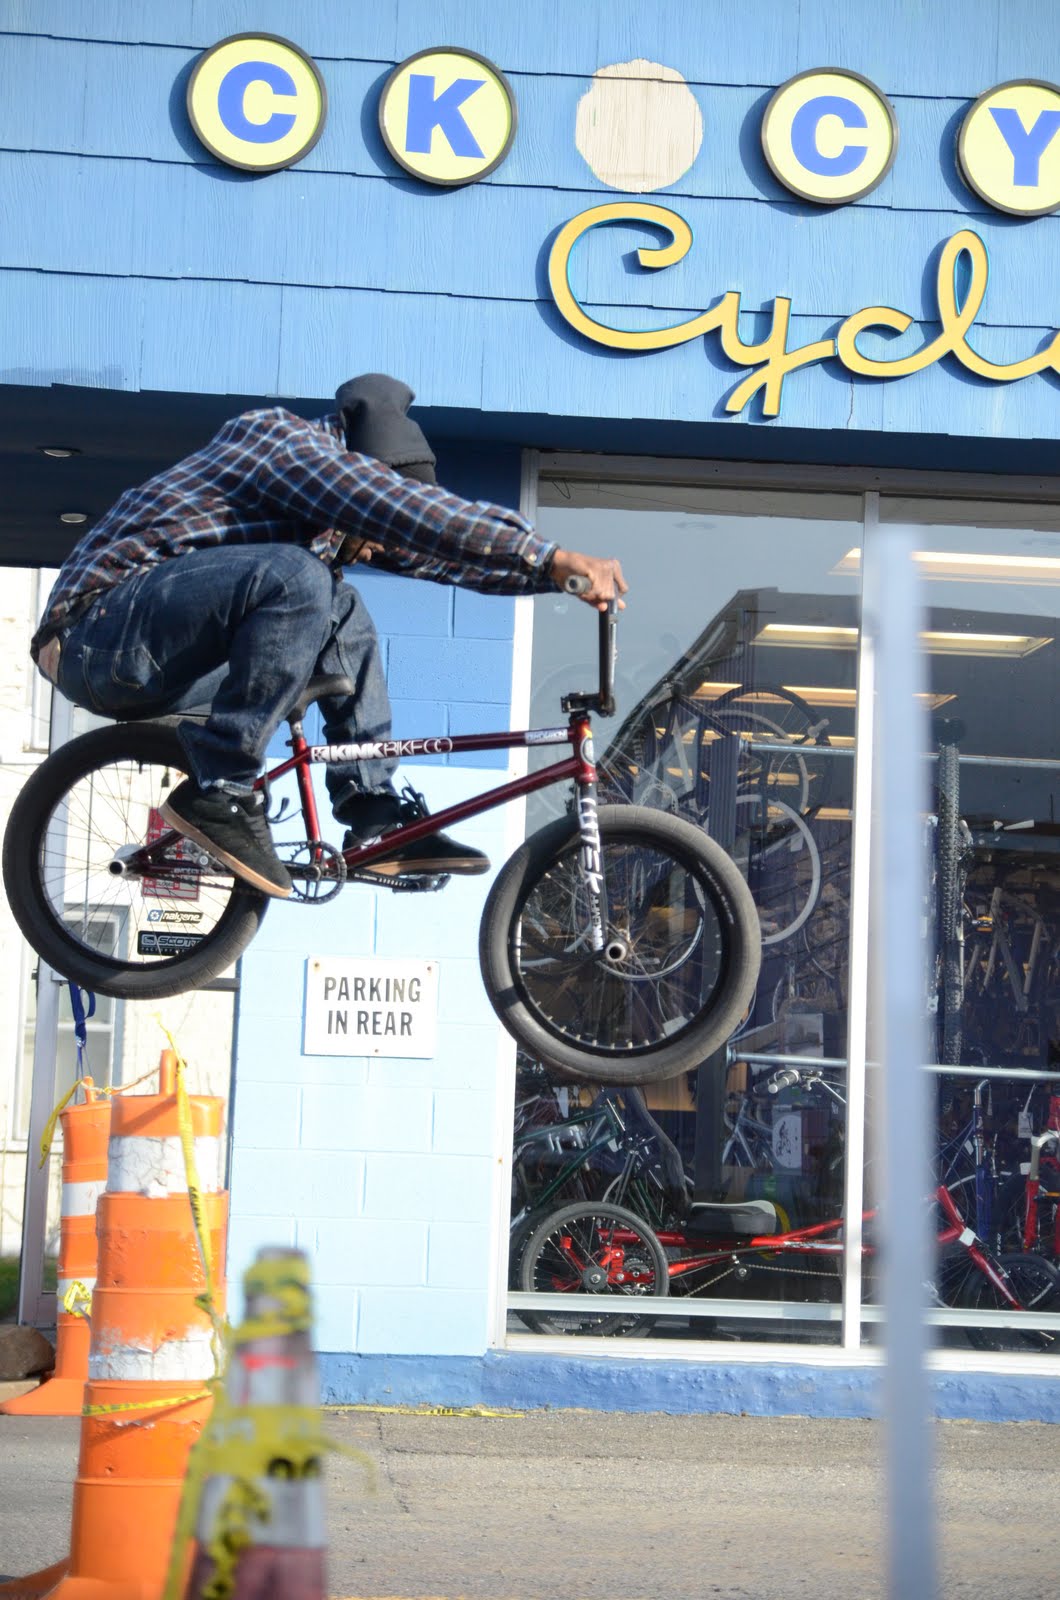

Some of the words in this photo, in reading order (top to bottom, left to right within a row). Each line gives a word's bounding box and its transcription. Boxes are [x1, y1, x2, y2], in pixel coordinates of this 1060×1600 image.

[549, 202, 1060, 418] Cycl
[162, 911, 200, 923] nalgene
[323, 976, 421, 1003] PARKING
[327, 1010, 348, 1034] IN
[356, 1010, 413, 1036] REAR
